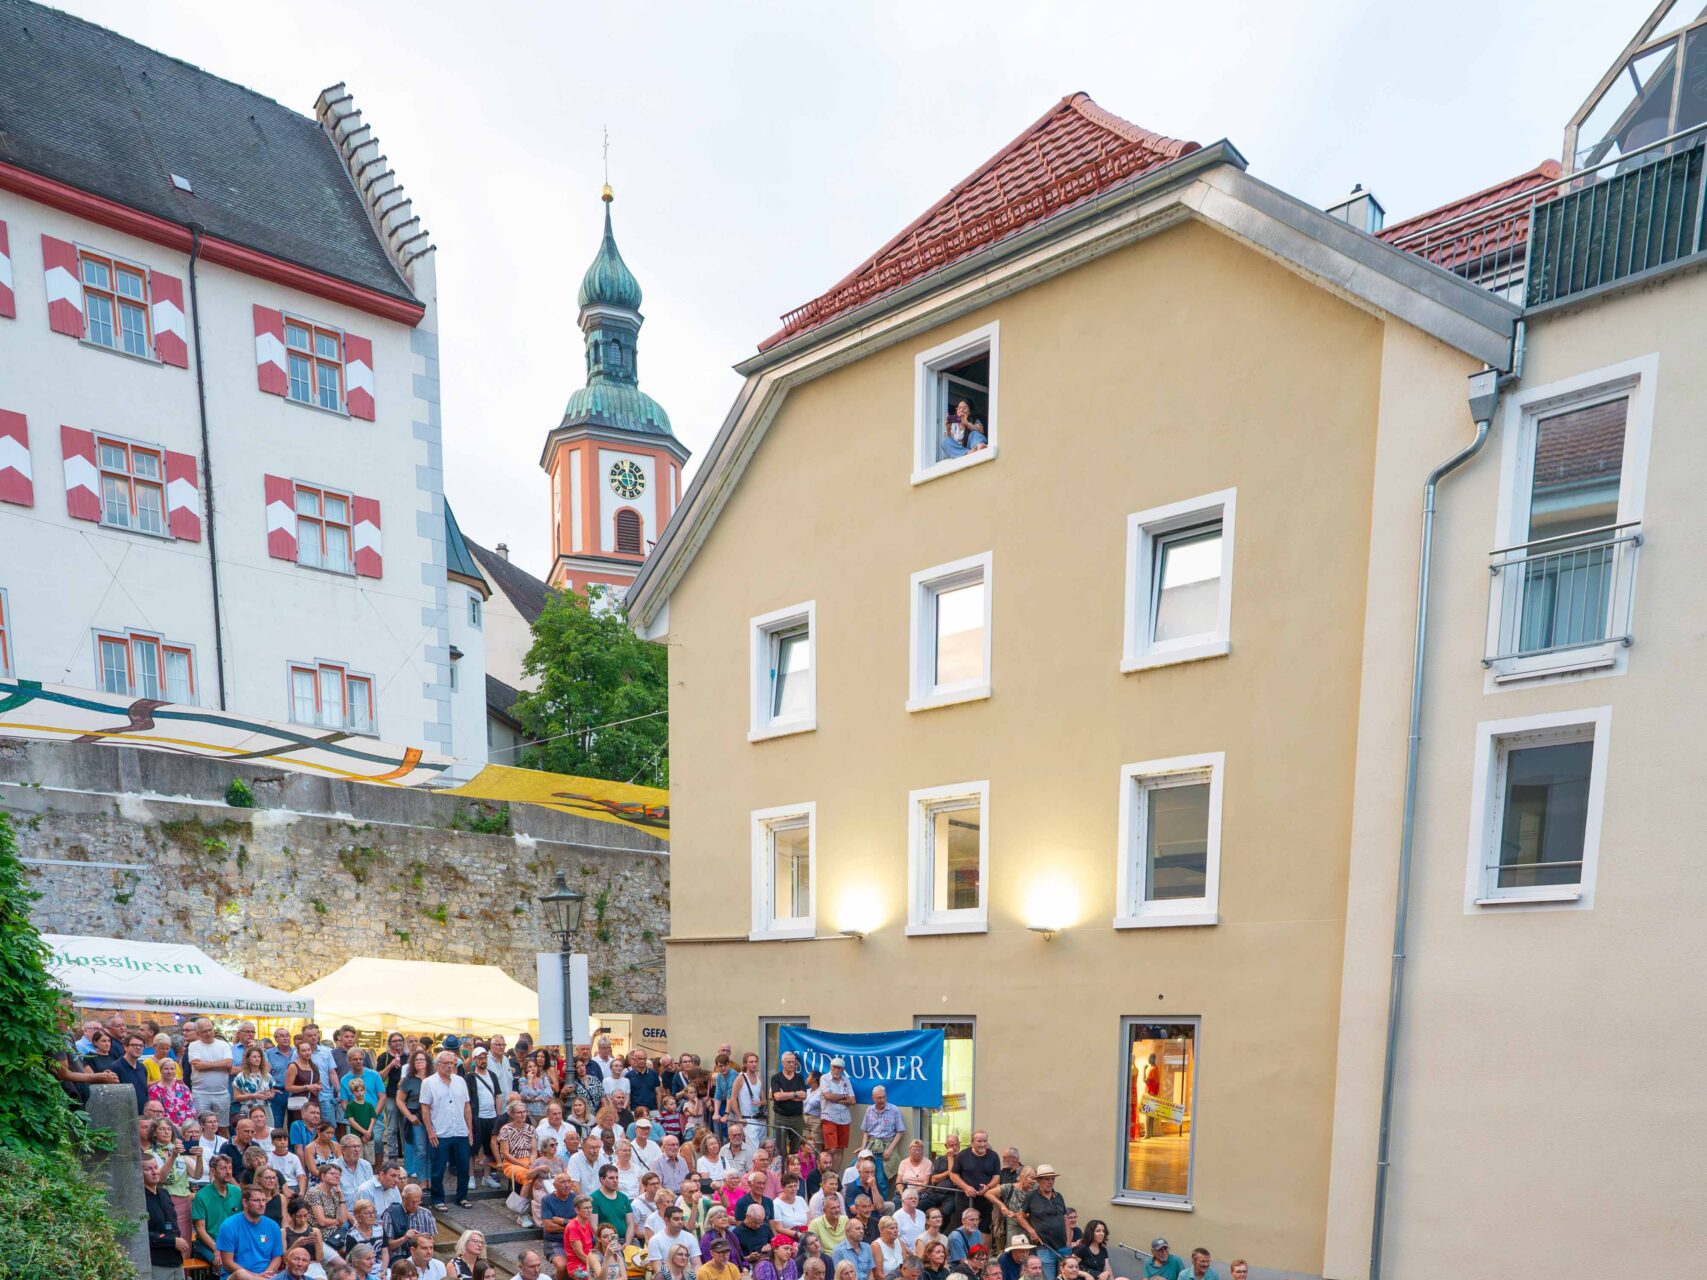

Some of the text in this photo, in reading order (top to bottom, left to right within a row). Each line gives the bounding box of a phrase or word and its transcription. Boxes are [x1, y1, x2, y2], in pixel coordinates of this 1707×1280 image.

[48, 952, 203, 975] hlosshexen
[144, 997, 230, 1010] Schlosshexen
[234, 998, 283, 1013] Tiengen
